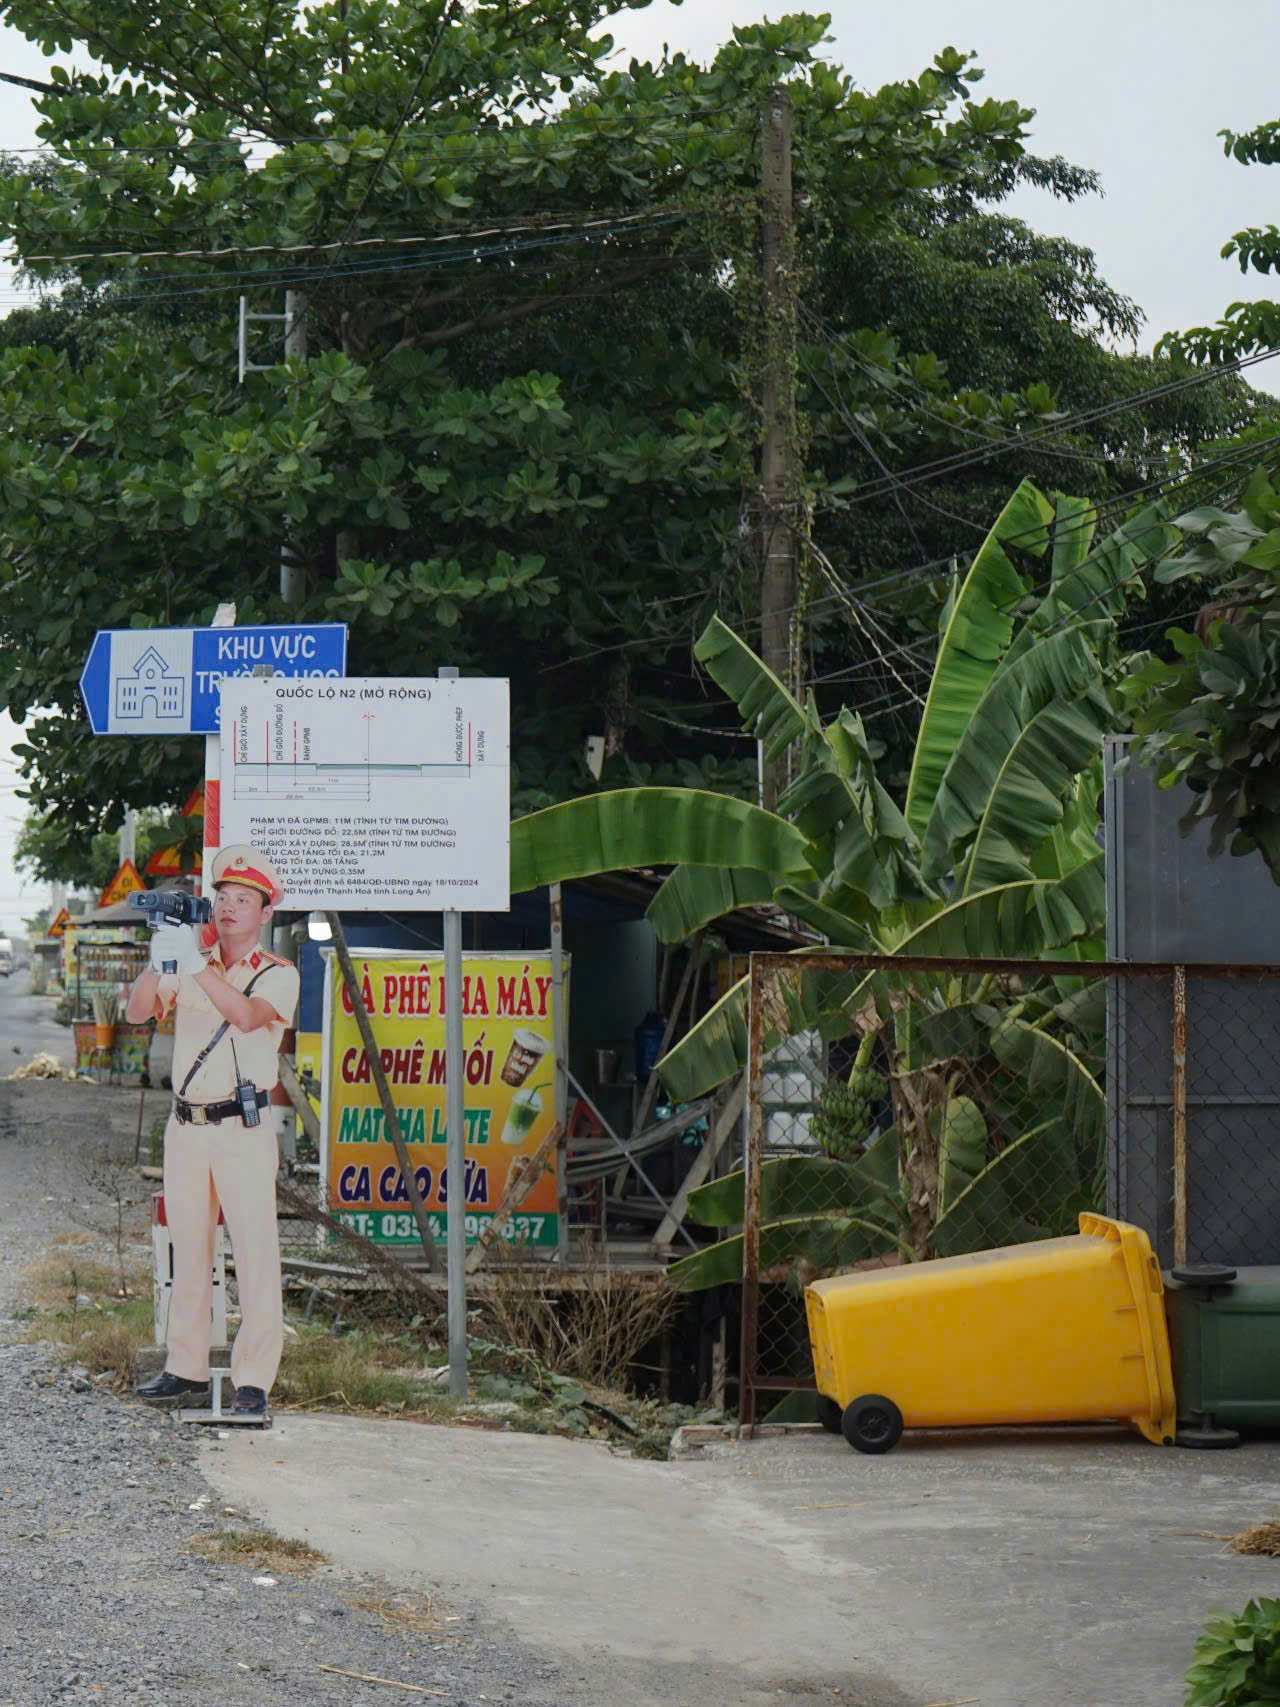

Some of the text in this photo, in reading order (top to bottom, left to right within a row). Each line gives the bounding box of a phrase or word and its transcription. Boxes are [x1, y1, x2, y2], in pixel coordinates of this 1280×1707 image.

[218, 633, 316, 664] KHU VỰC
[276, 685, 431, 700] QUỐC LỘ N2 (MỞ RỘNG)
[290, 838, 307, 846] XÂY
[291, 866, 309, 874] XÂY
[383, 964, 431, 1014] PHÊ
[497, 964, 553, 1016] MÁY
[380, 1039, 425, 1084] PHÊ
[427, 1031, 494, 1085] MỐI
[340, 1165, 371, 1202] CA
[380, 1166, 432, 1202] CAO
